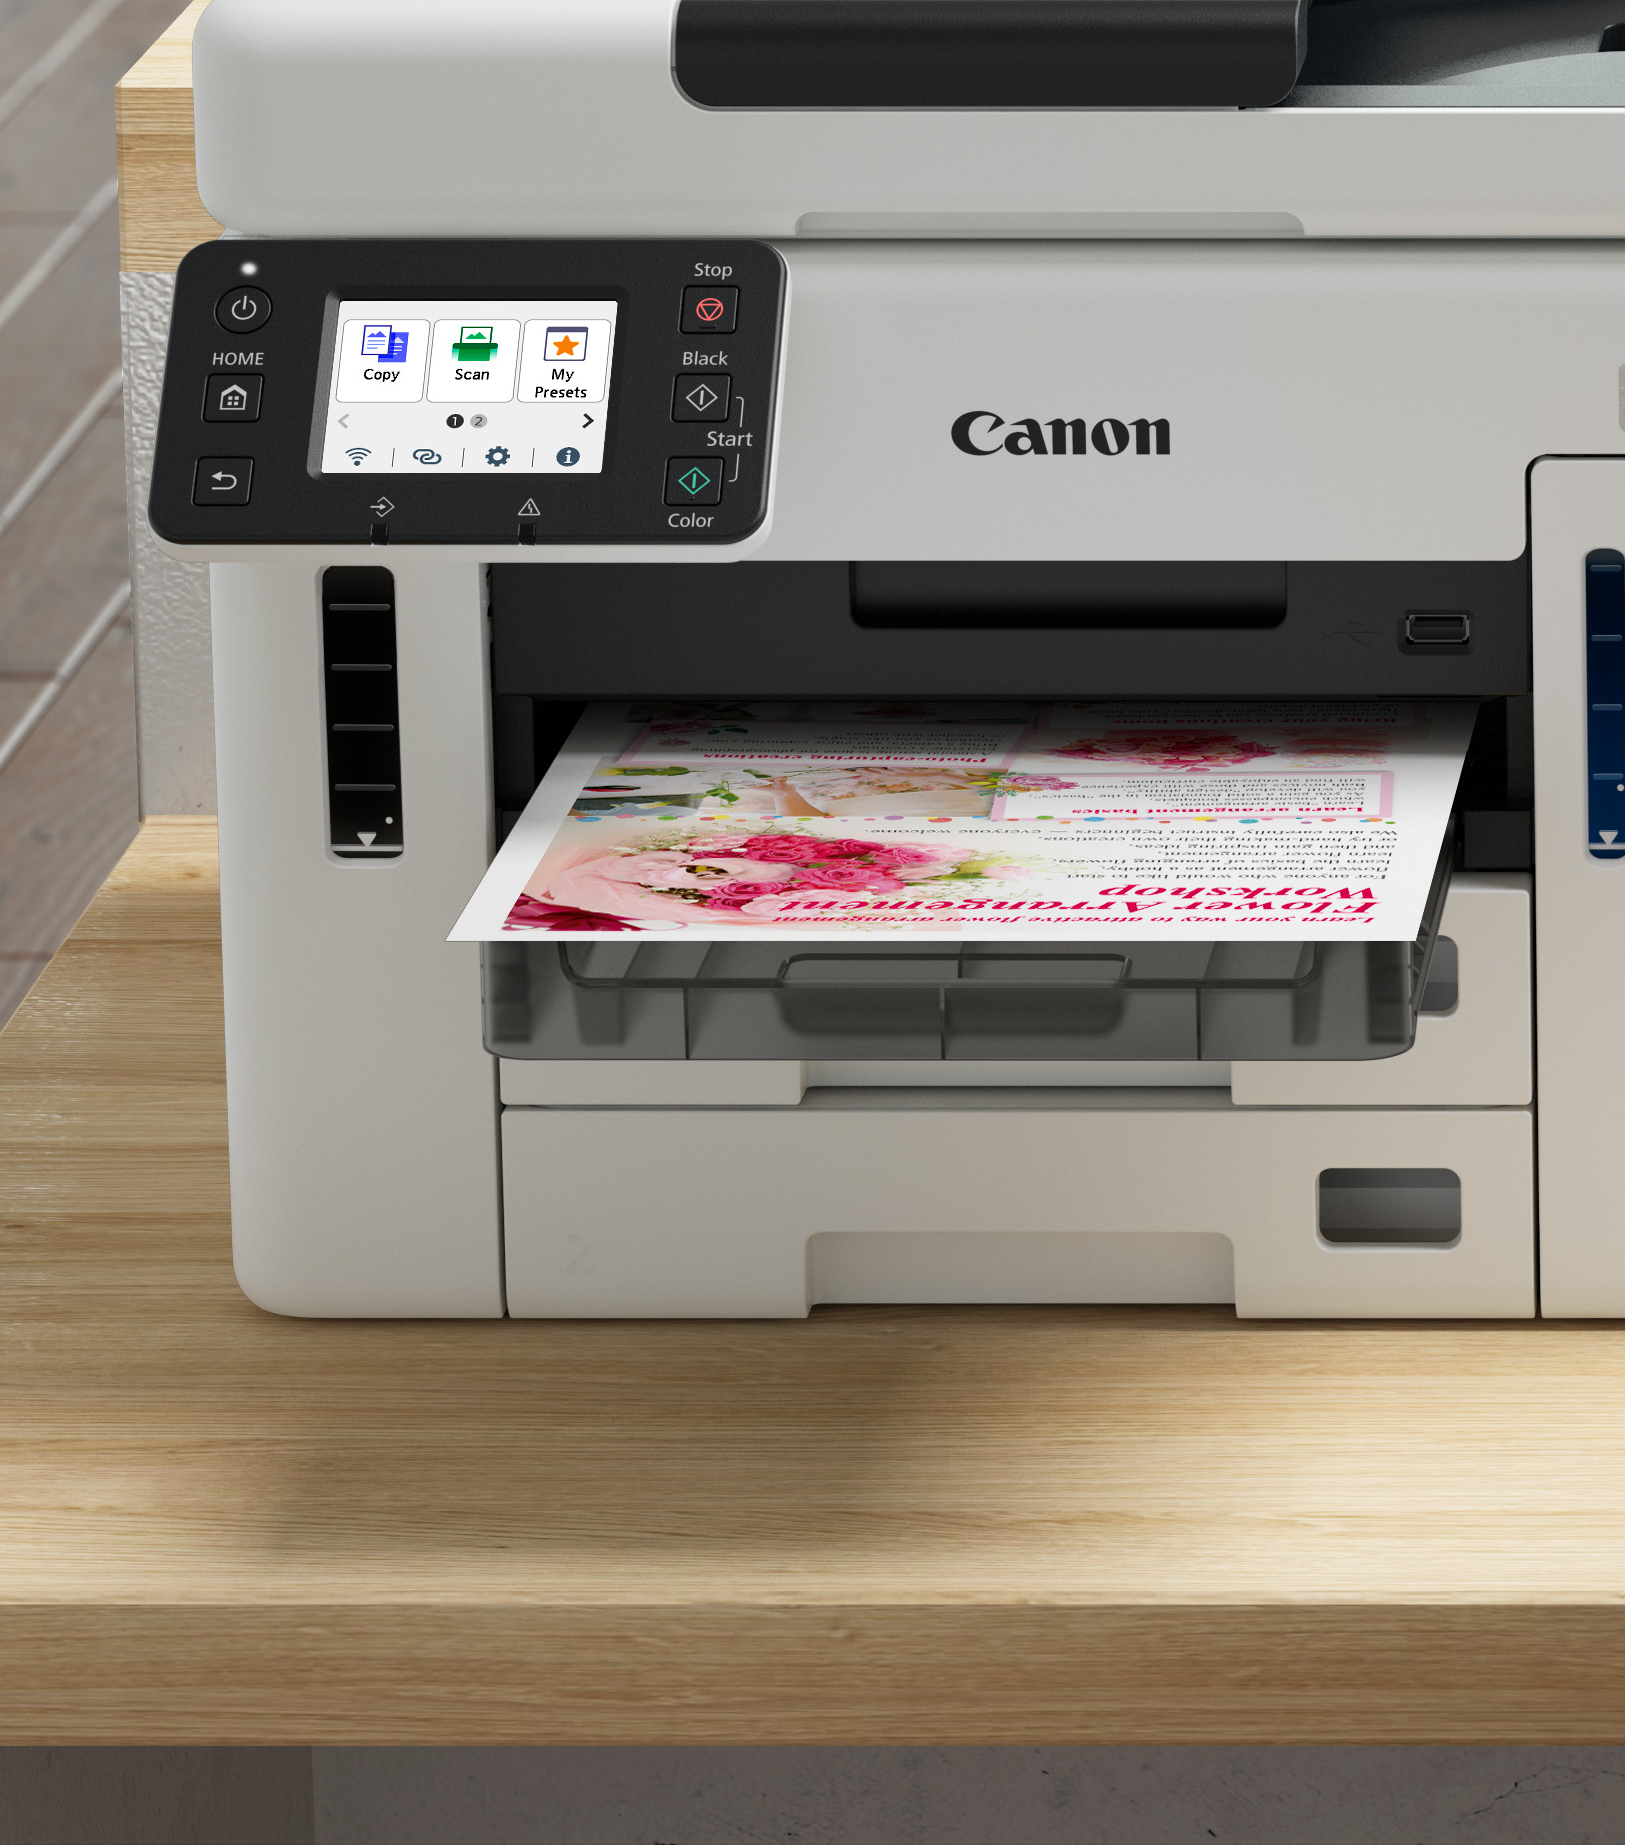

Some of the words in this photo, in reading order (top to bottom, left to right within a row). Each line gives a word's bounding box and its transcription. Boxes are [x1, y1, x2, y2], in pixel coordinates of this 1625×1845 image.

[693, 262, 733, 281] Stop
[212, 352, 265, 366] HOME
[682, 351, 728, 366] Black
[363, 368, 400, 382] Copy
[454, 368, 490, 381] Scan
[551, 368, 575, 383] My
[534, 386, 587, 400] Presets
[707, 431, 753, 447] Start
[951, 410, 1171, 456] Canon
[668, 514, 714, 528] Color
[1097, 883, 1379, 901] Workshop
[777, 900, 1166, 916] Arrangement
[1188, 901, 1382, 914] Flower
